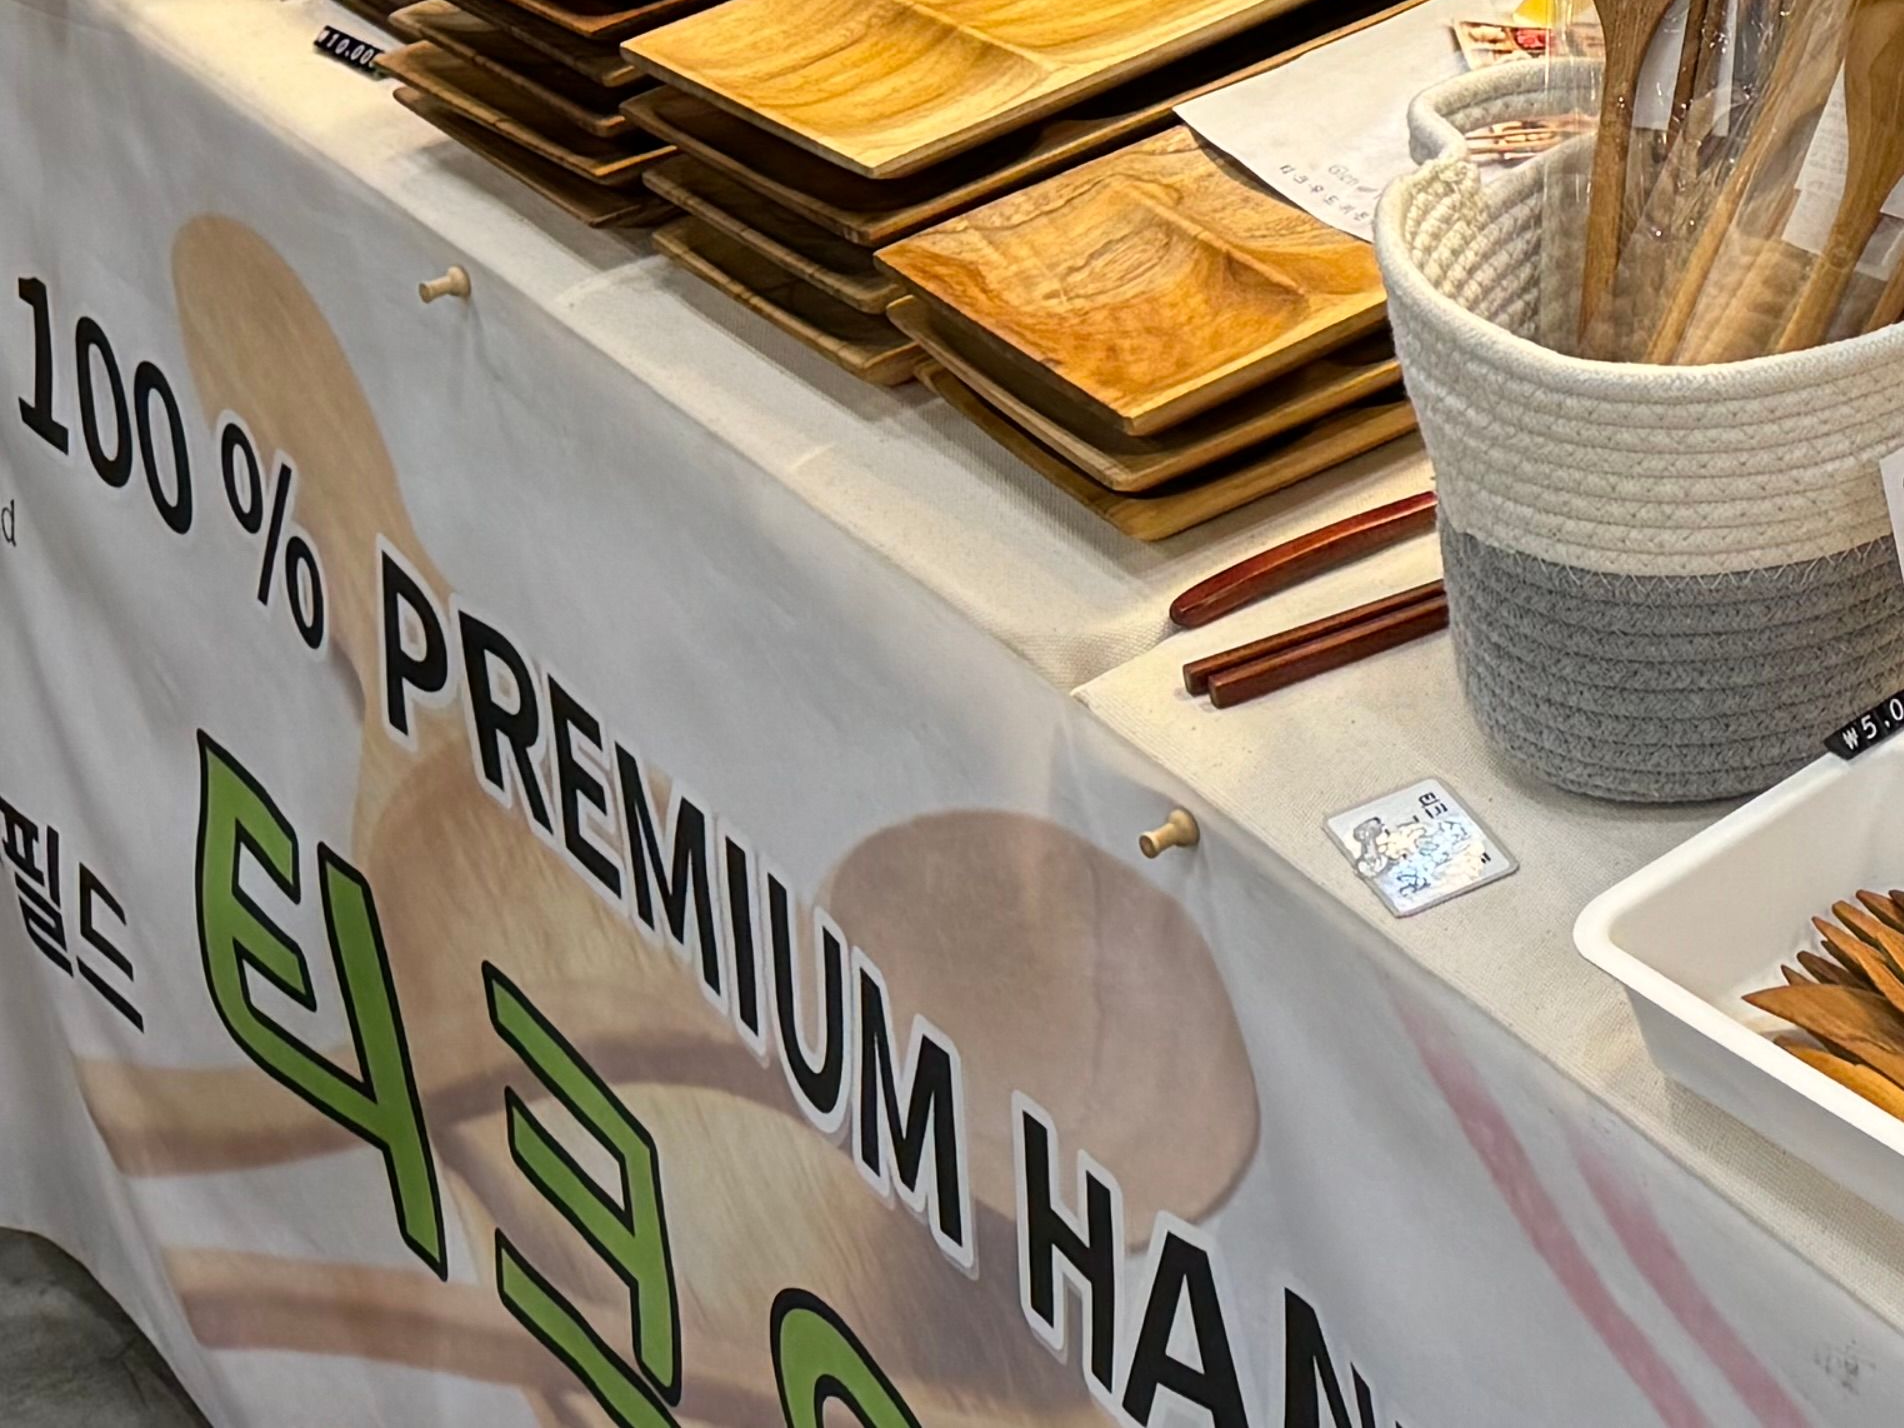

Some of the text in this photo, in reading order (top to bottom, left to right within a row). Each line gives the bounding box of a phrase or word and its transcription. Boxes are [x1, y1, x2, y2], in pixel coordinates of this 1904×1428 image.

[17, 276, 194, 535] 100
[220, 420, 326, 650] %
[380, 547, 965, 1249] PREMIUM
